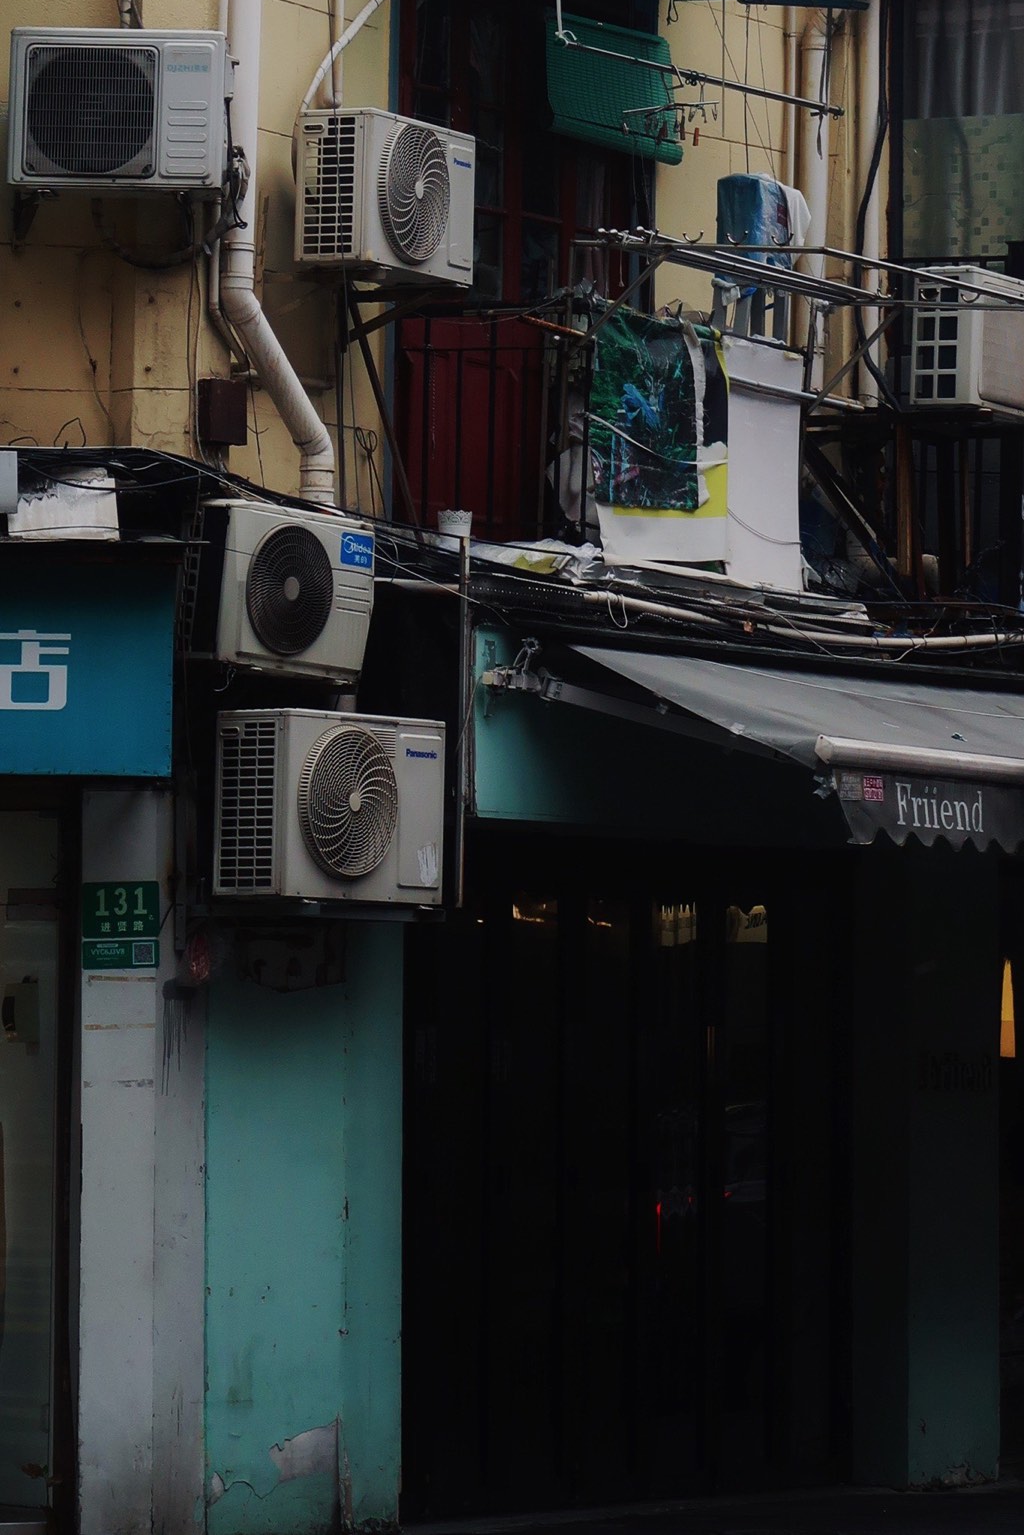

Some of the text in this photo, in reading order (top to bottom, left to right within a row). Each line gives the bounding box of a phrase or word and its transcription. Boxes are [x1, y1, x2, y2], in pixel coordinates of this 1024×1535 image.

[406, 748, 437, 759] Panasonic
[895, 782, 984, 833] Friiend
[95, 887, 147, 916] 131
[100, 920, 144, 933] 进贤路
